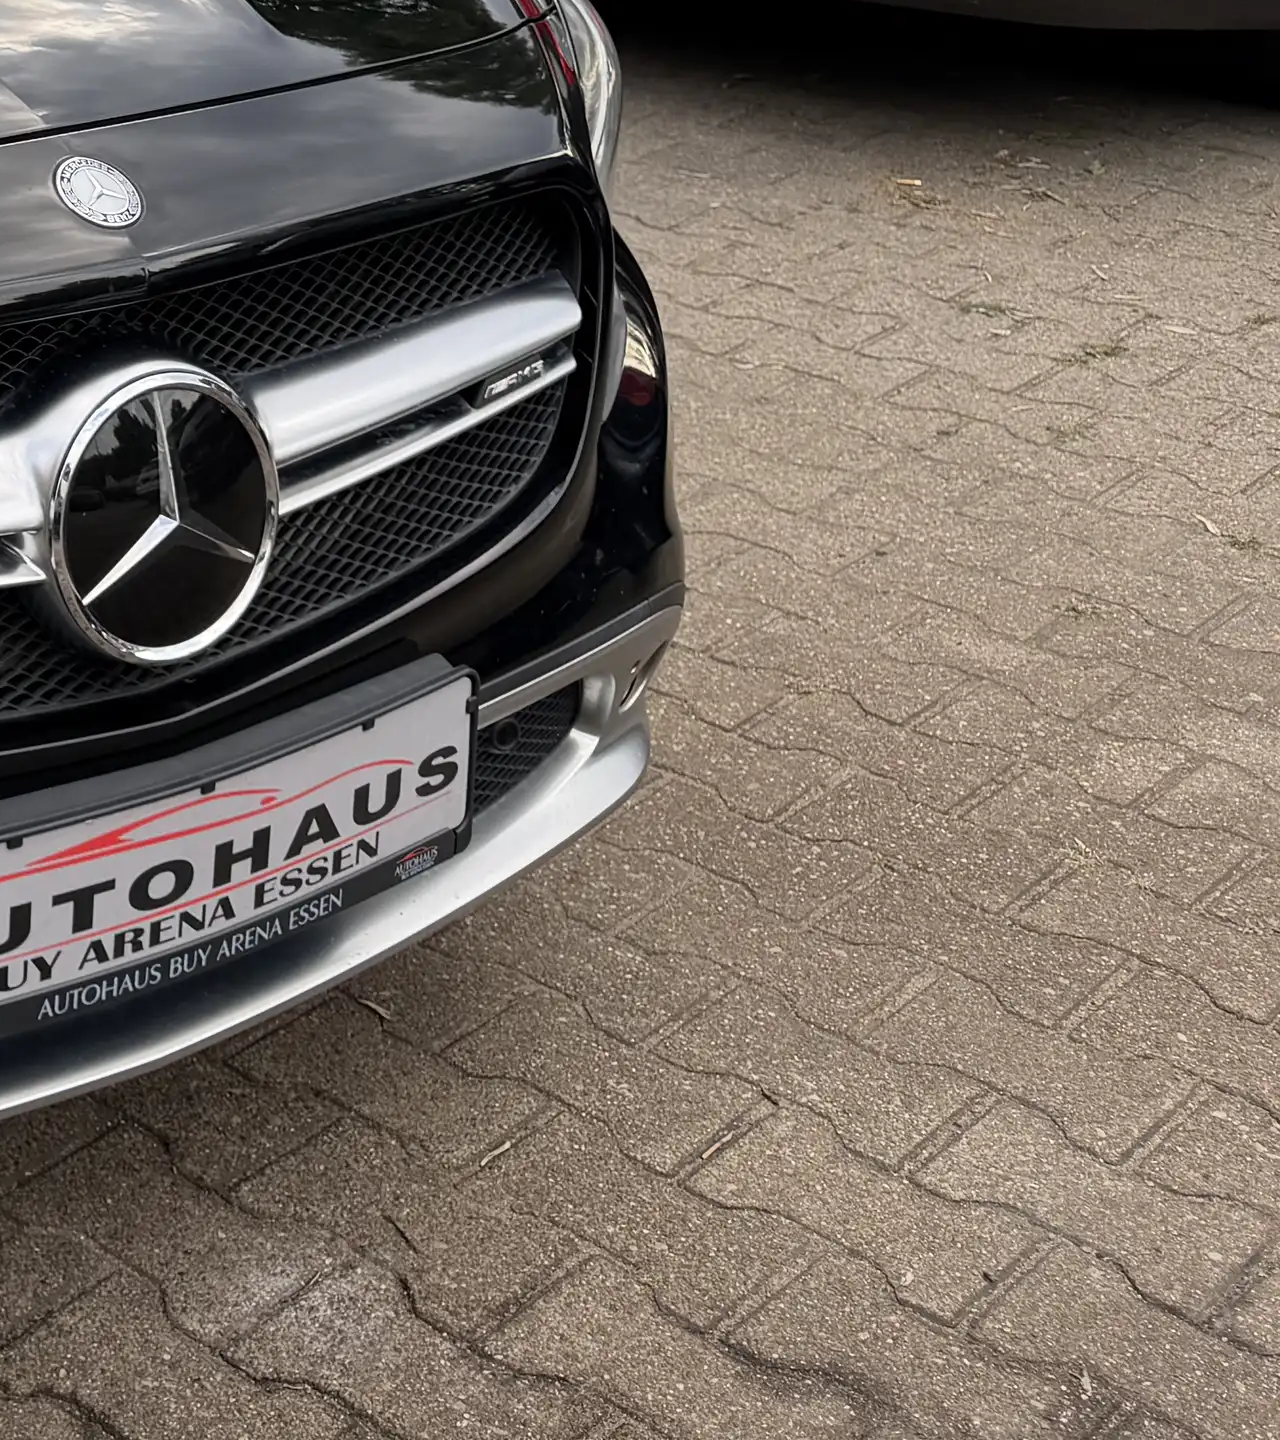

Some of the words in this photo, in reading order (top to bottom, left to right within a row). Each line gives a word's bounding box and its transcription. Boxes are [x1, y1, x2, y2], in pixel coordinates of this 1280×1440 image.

[78, 895, 237, 972] ARENA
[253, 830, 381, 910] ESSEN
[394, 849, 439, 877] AUTOHAUS
[37, 963, 163, 1020] AUTOHAUS
[169, 943, 213, 979] BUY
[216, 917, 284, 962] ARENA
[288, 888, 343, 932] ESSEN
